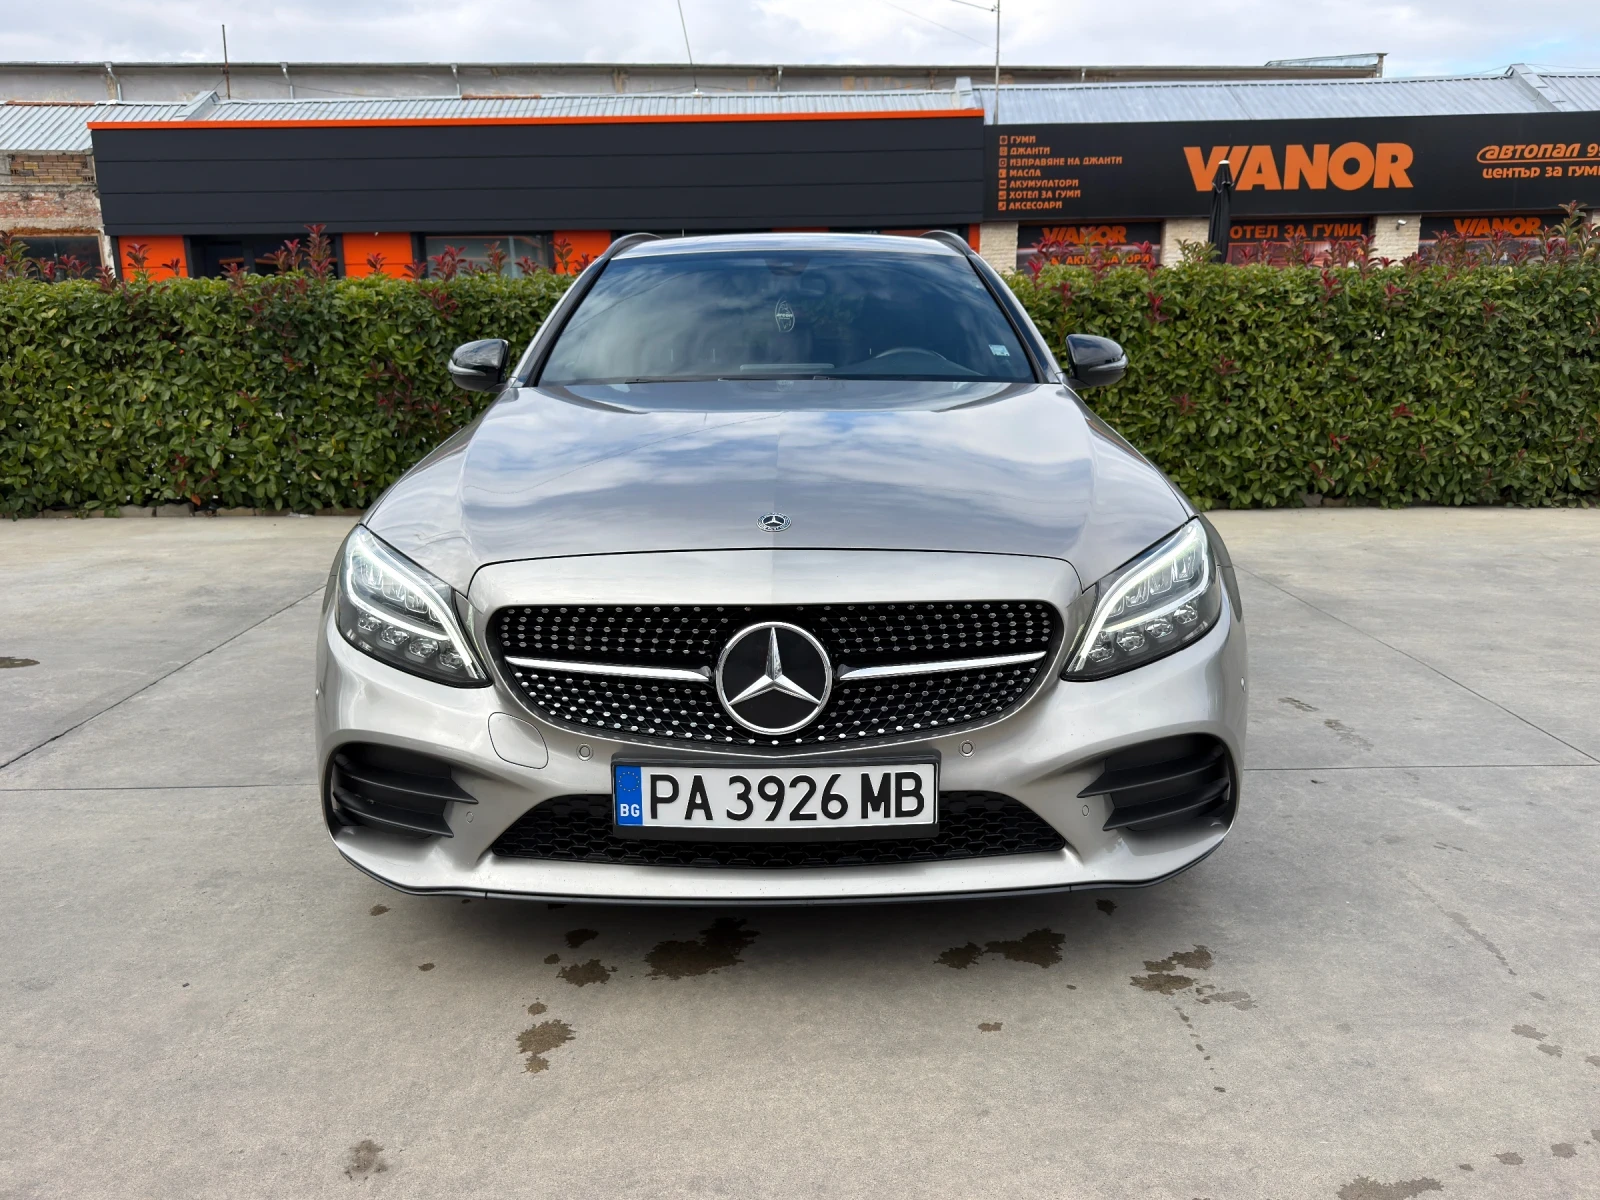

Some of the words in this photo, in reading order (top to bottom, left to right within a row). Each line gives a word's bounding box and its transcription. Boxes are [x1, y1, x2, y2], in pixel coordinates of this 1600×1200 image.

[1010, 135, 1036, 144] ГУМИ
[1010, 147, 1050, 155] ДЖАНТИ
[1478, 143, 1581, 161] автопал
[1586, 143, 1600, 157] 9
[1009, 158, 1065, 166] ИЗПРАВЯНЕ
[1083, 156, 1123, 165] ДЖАНТИ
[1183, 142, 1414, 191] VIANOR
[1009, 169, 1041, 177] МАСЛА
[1482, 167, 1540, 179] център
[1545, 166, 1562, 177] за
[1009, 179, 1079, 188] АКУМУЛАТОРИ
[1009, 191, 1039, 199] ХОТЕЛ
[1041, 190, 1053, 198] ЗА
[1055, 190, 1081, 198] ГУМИ
[1008, 201, 1063, 210] АКСЕСОАРИ
[1229, 225, 1278, 239] ОТЕЛ
[1284, 224, 1307, 238] ЗА
[1312, 223, 1362, 237] ГУМИ
[1453, 217, 1542, 237] VIANOR
[620, 803, 640, 818] BG
[650, 774, 714, 821] PA
[726, 774, 848, 822] 3926
[861, 772, 924, 819] MB
